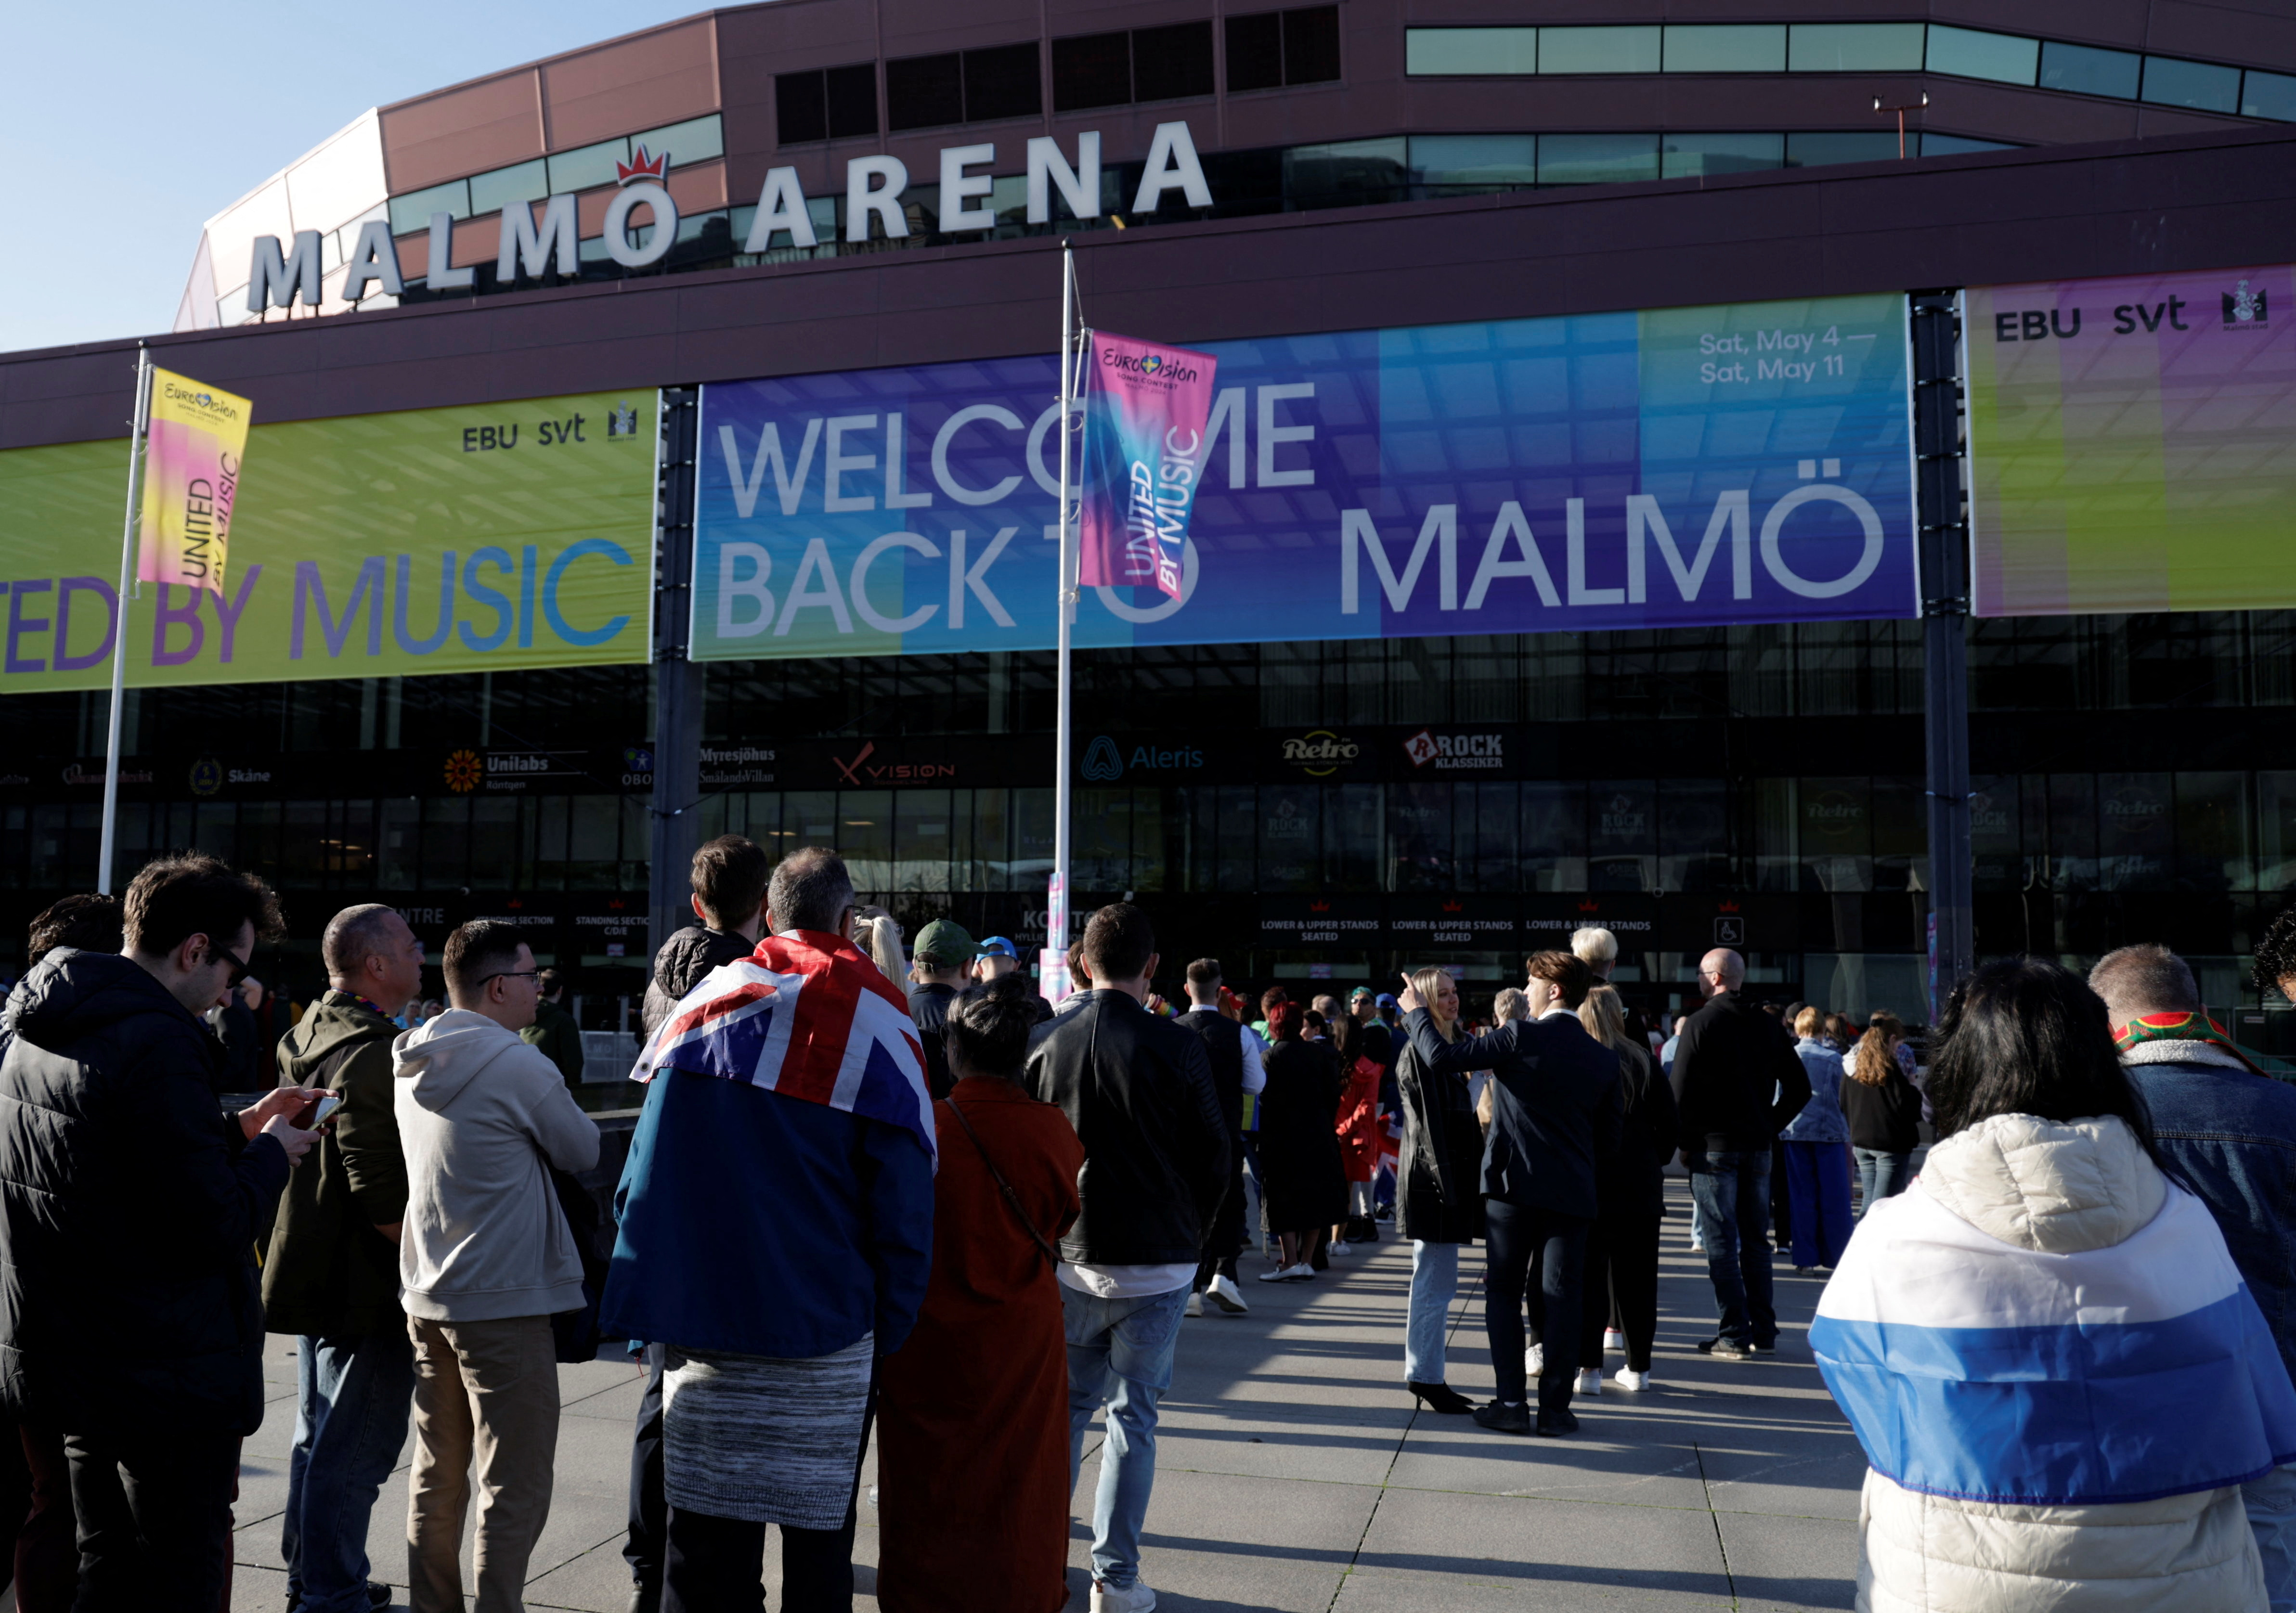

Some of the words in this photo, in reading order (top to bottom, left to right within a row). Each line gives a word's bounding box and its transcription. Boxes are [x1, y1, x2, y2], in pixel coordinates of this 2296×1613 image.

[744, 120, 1214, 255] ARENA
[1996, 306, 2081, 342] EBU
[2113, 294, 2190, 335] svt
[1699, 332, 1749, 357] Sat,
[1757, 329, 1814, 355] May
[1822, 325, 1841, 347] 4
[1700, 360, 1750, 386] Sat,
[1758, 358, 1817, 383] May
[1822, 354, 1844, 377] 11
[1116, 372, 1139, 382] SONG
[1141, 377, 1179, 390] CONTEST
[462, 424, 518, 452] EBU
[538, 413, 586, 445] svt
[1156, 424, 1199, 543] MUSIC
[217, 451, 238, 544] MUSIC
[1125, 459, 1155, 576] UNITED
[181, 478, 213, 578] UNITED
[1341, 457, 1884, 614] MALMÖ
[213, 549, 222, 587] BY
[1159, 544, 1178, 592] BY
[716, 527, 1019, 638] BACK
[151, 564, 263, 666] BY
[290, 538, 634, 660] MUSIC
[1282, 738, 1359, 759] Retro
[1436, 735, 1503, 757] ROCK
[486, 756, 549, 772] Unilabs
[699, 747, 776, 765] Myresjöhus
[1129, 745, 1204, 769] Aleris
[1435, 757, 1504, 769] KLASSIKER
[228, 767, 272, 783] Skåne
[622, 774, 652, 786] OBO
[699, 769, 775, 783] SmålandsVillan
[486, 780, 527, 791] Röntgen
[1971, 811, 2007, 826] OCK
[394, 907, 445, 924] NTRE
[518, 916, 554, 925] SECTION
[575, 916, 619, 925] STANDING
[620, 916, 649, 925] SECTIO
[604, 926, 628, 936] C/D/E
[1261, 920, 1296, 930] LOWER
[1297, 920, 1305, 930] &
[1306, 920, 1339, 930] UPPER
[1340, 920, 1379, 930] STANDS
[1392, 920, 1427, 931] LOWER
[1428, 920, 1437, 931] &
[1438, 920, 1472, 931] UPPER
[1472, 920, 1514, 931] STANDS
[1526, 920, 1563, 929] LOWER
[1563, 920, 1573, 930] &
[1609, 920, 1651, 931] STANDS
[1014, 932, 1045, 942] HYLLIE
[1301, 932, 1338, 942] SEATED
[1433, 932, 1472, 942] SEATED
